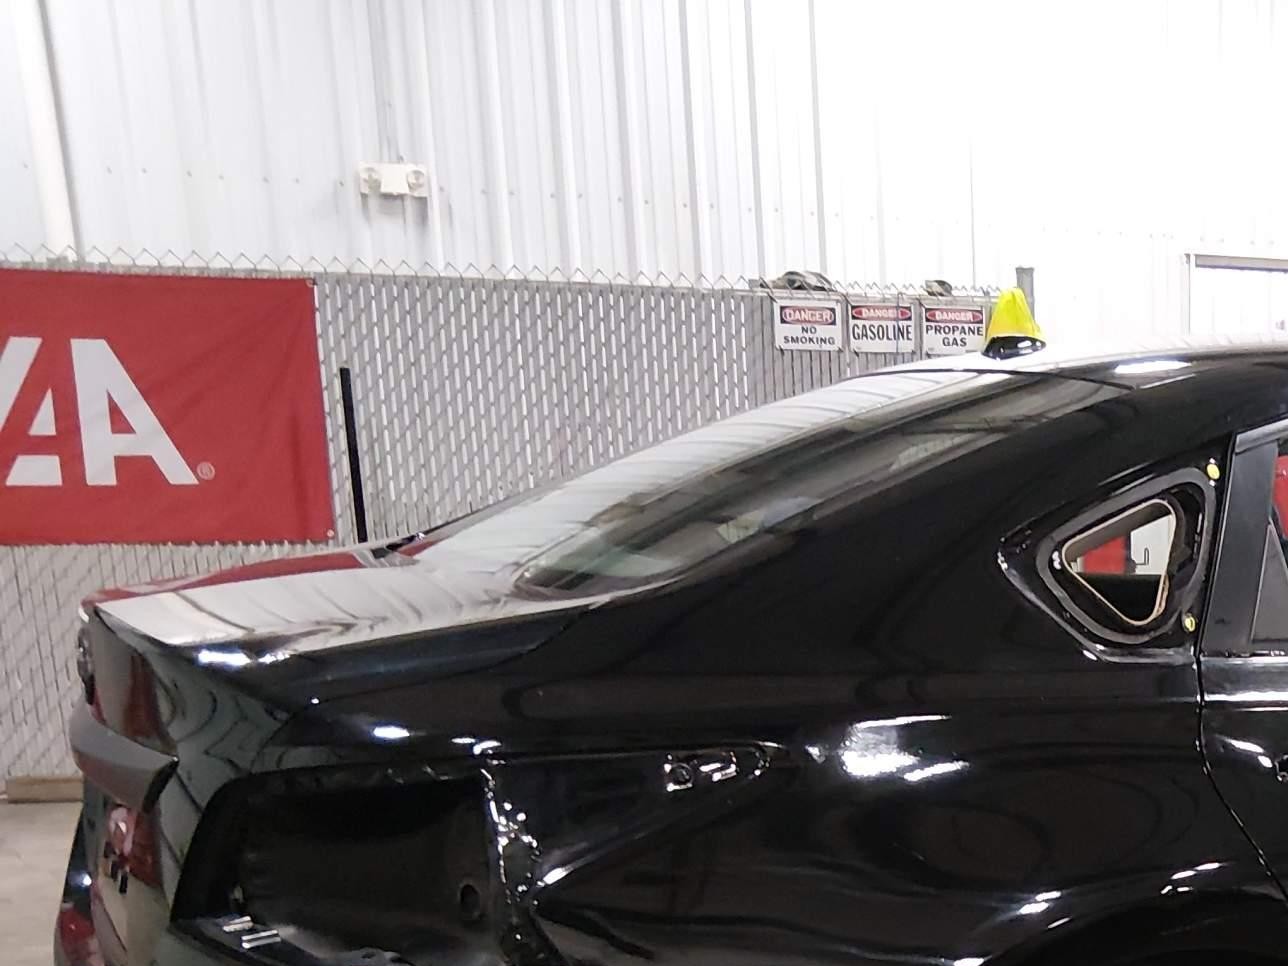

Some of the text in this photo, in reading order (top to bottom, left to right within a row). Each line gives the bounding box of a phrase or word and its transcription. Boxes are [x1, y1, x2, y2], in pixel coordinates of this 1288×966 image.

[785, 308, 831, 322] DANGER
[935, 310, 974, 322] DANGER
[801, 325, 817, 335] NO
[851, 323, 913, 342] GASOLINE
[925, 324, 984, 337] PROPANE
[783, 335, 836, 346] SMOKING
[942, 336, 968, 348] GAS
